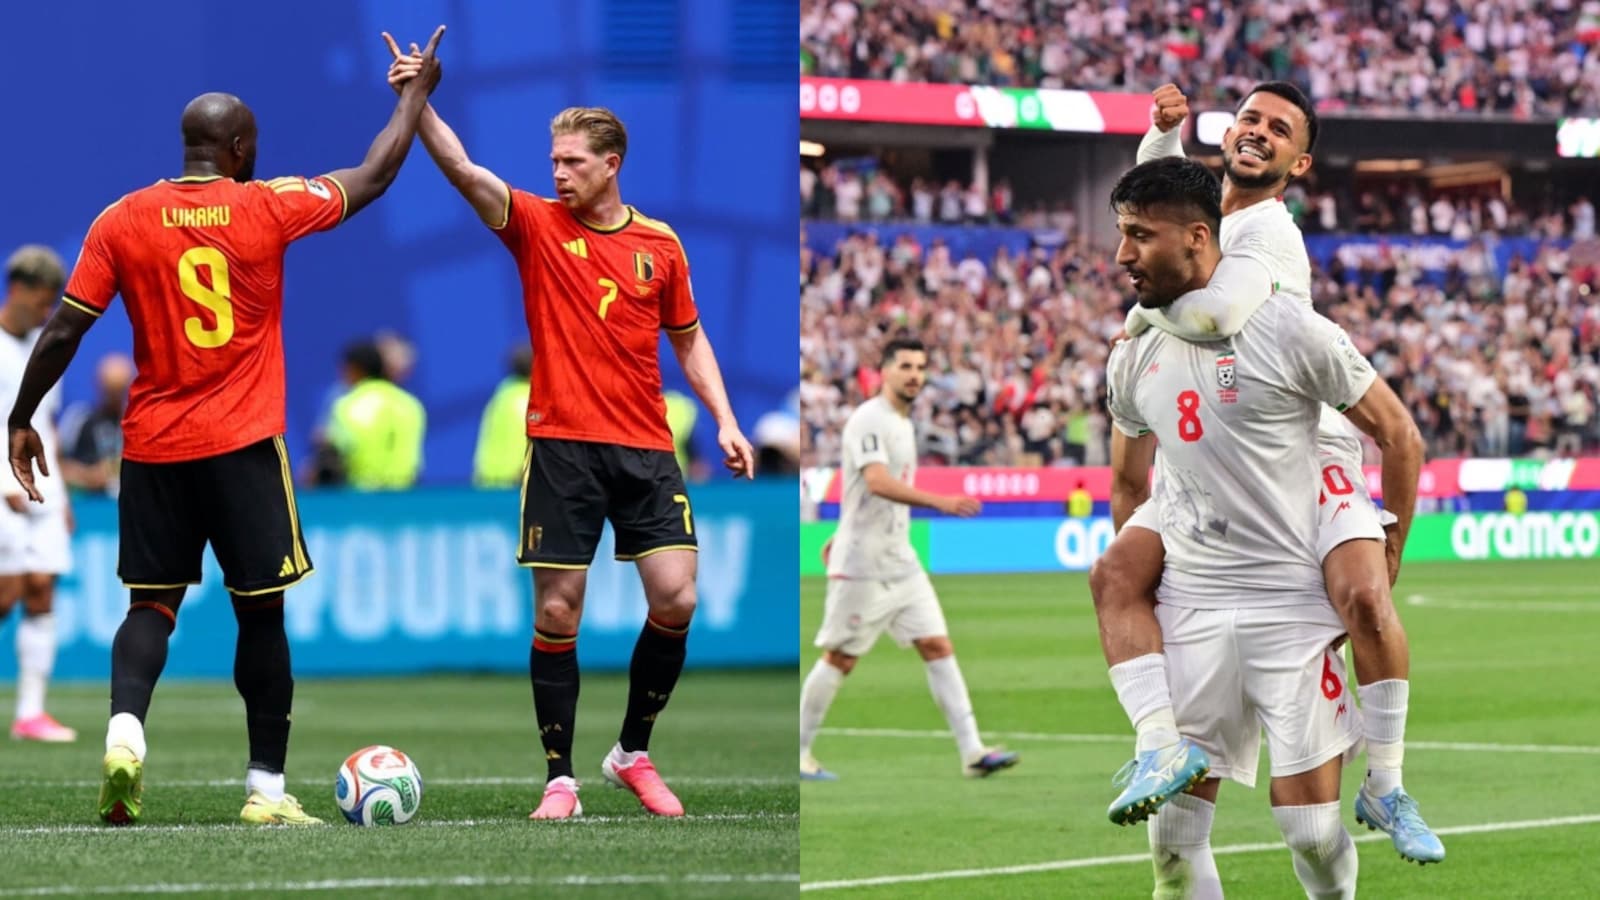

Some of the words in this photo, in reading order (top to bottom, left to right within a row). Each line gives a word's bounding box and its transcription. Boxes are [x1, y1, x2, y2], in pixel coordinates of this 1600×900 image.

[161, 205, 231, 228] LUKAKU
[178, 246, 235, 348] 9
[597, 278, 618, 320] 7
[1177, 390, 1203, 442] 8
[1318, 464, 1354, 507] 0
[673, 494, 692, 535] 7
[1452, 512, 1600, 559] aramco
[283, 524, 523, 642] YOUR
